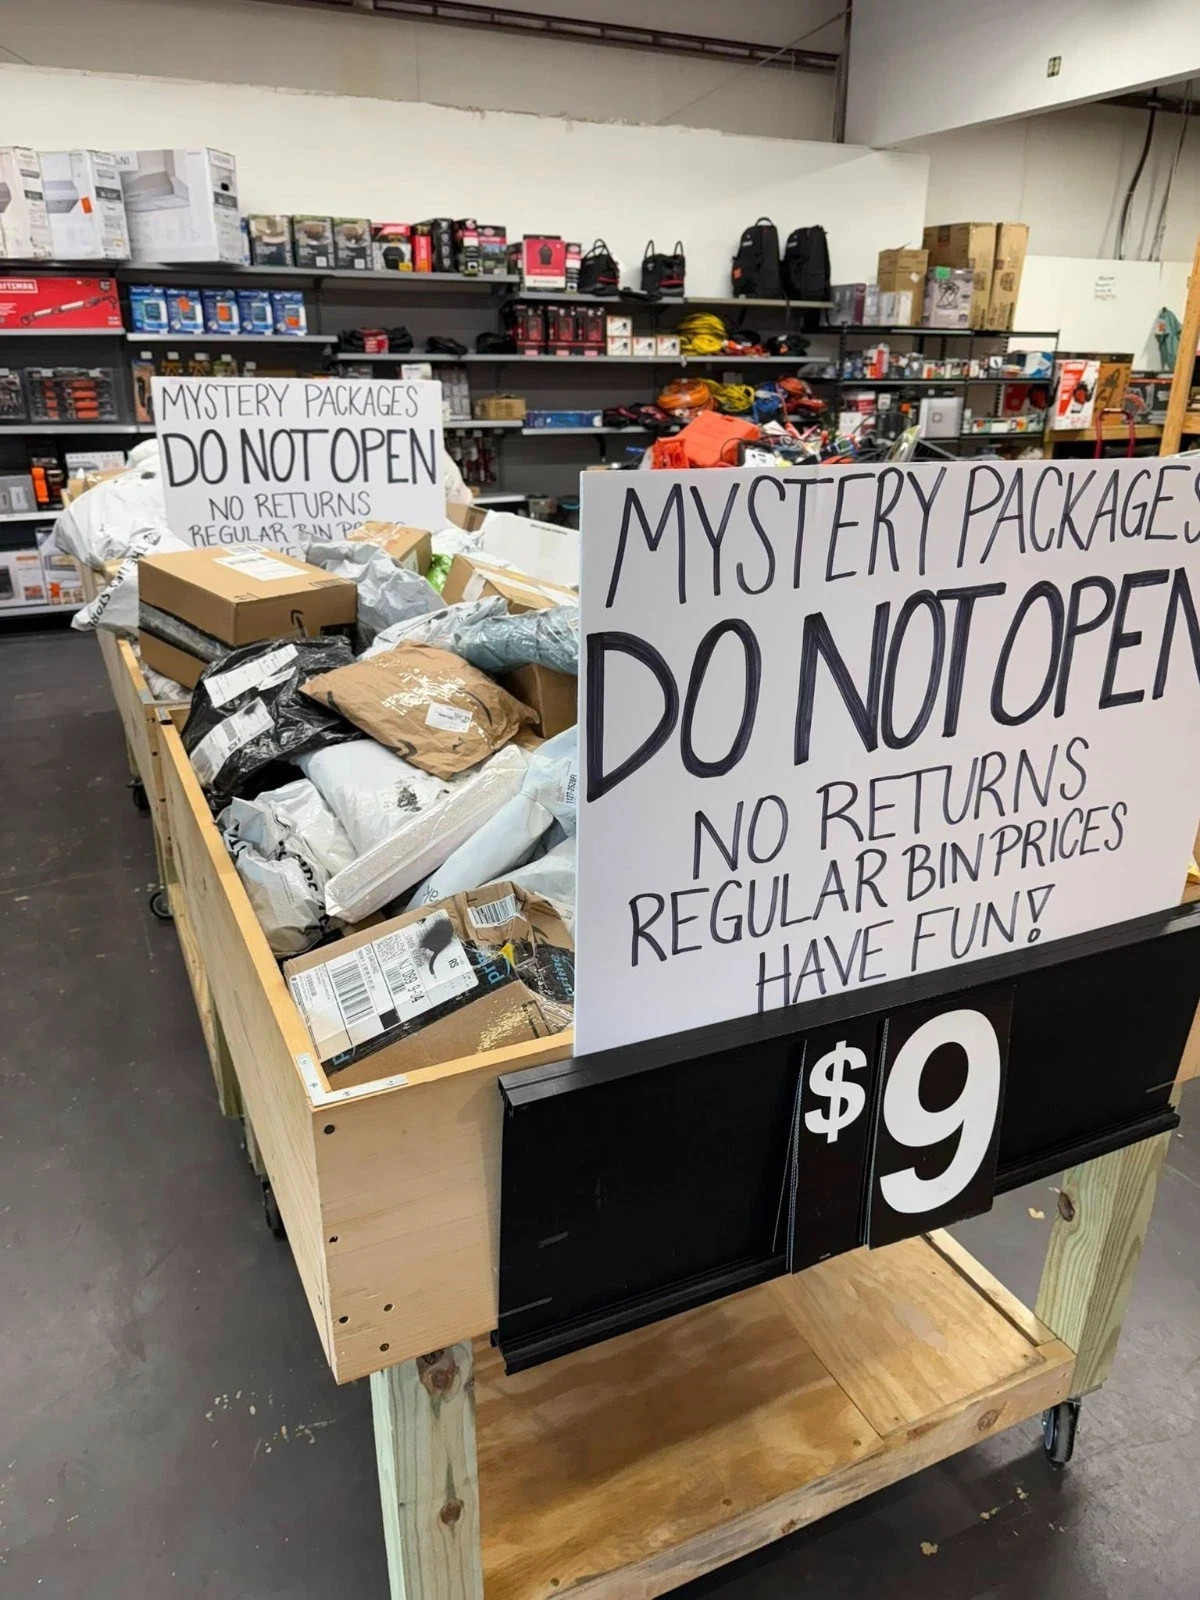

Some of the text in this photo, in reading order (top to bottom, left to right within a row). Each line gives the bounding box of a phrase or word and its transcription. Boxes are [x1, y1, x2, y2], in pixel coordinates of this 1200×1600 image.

[162, 383, 418, 421] MYSTERY PACKAGES
[162, 427, 437, 488] DO NOT OPEN
[188, 523, 289, 547] REGULAR
[208, 490, 371, 521] NO RETURNS
[606, 466, 948, 610] MYSTERY
[586, 567, 1200, 804] DO NOT OPEN
[692, 736, 1089, 881] NO RETURNS
[628, 801, 1128, 967] REGULAR BIN PRICES
[755, 883, 1057, 1014] HAVE FUN!
